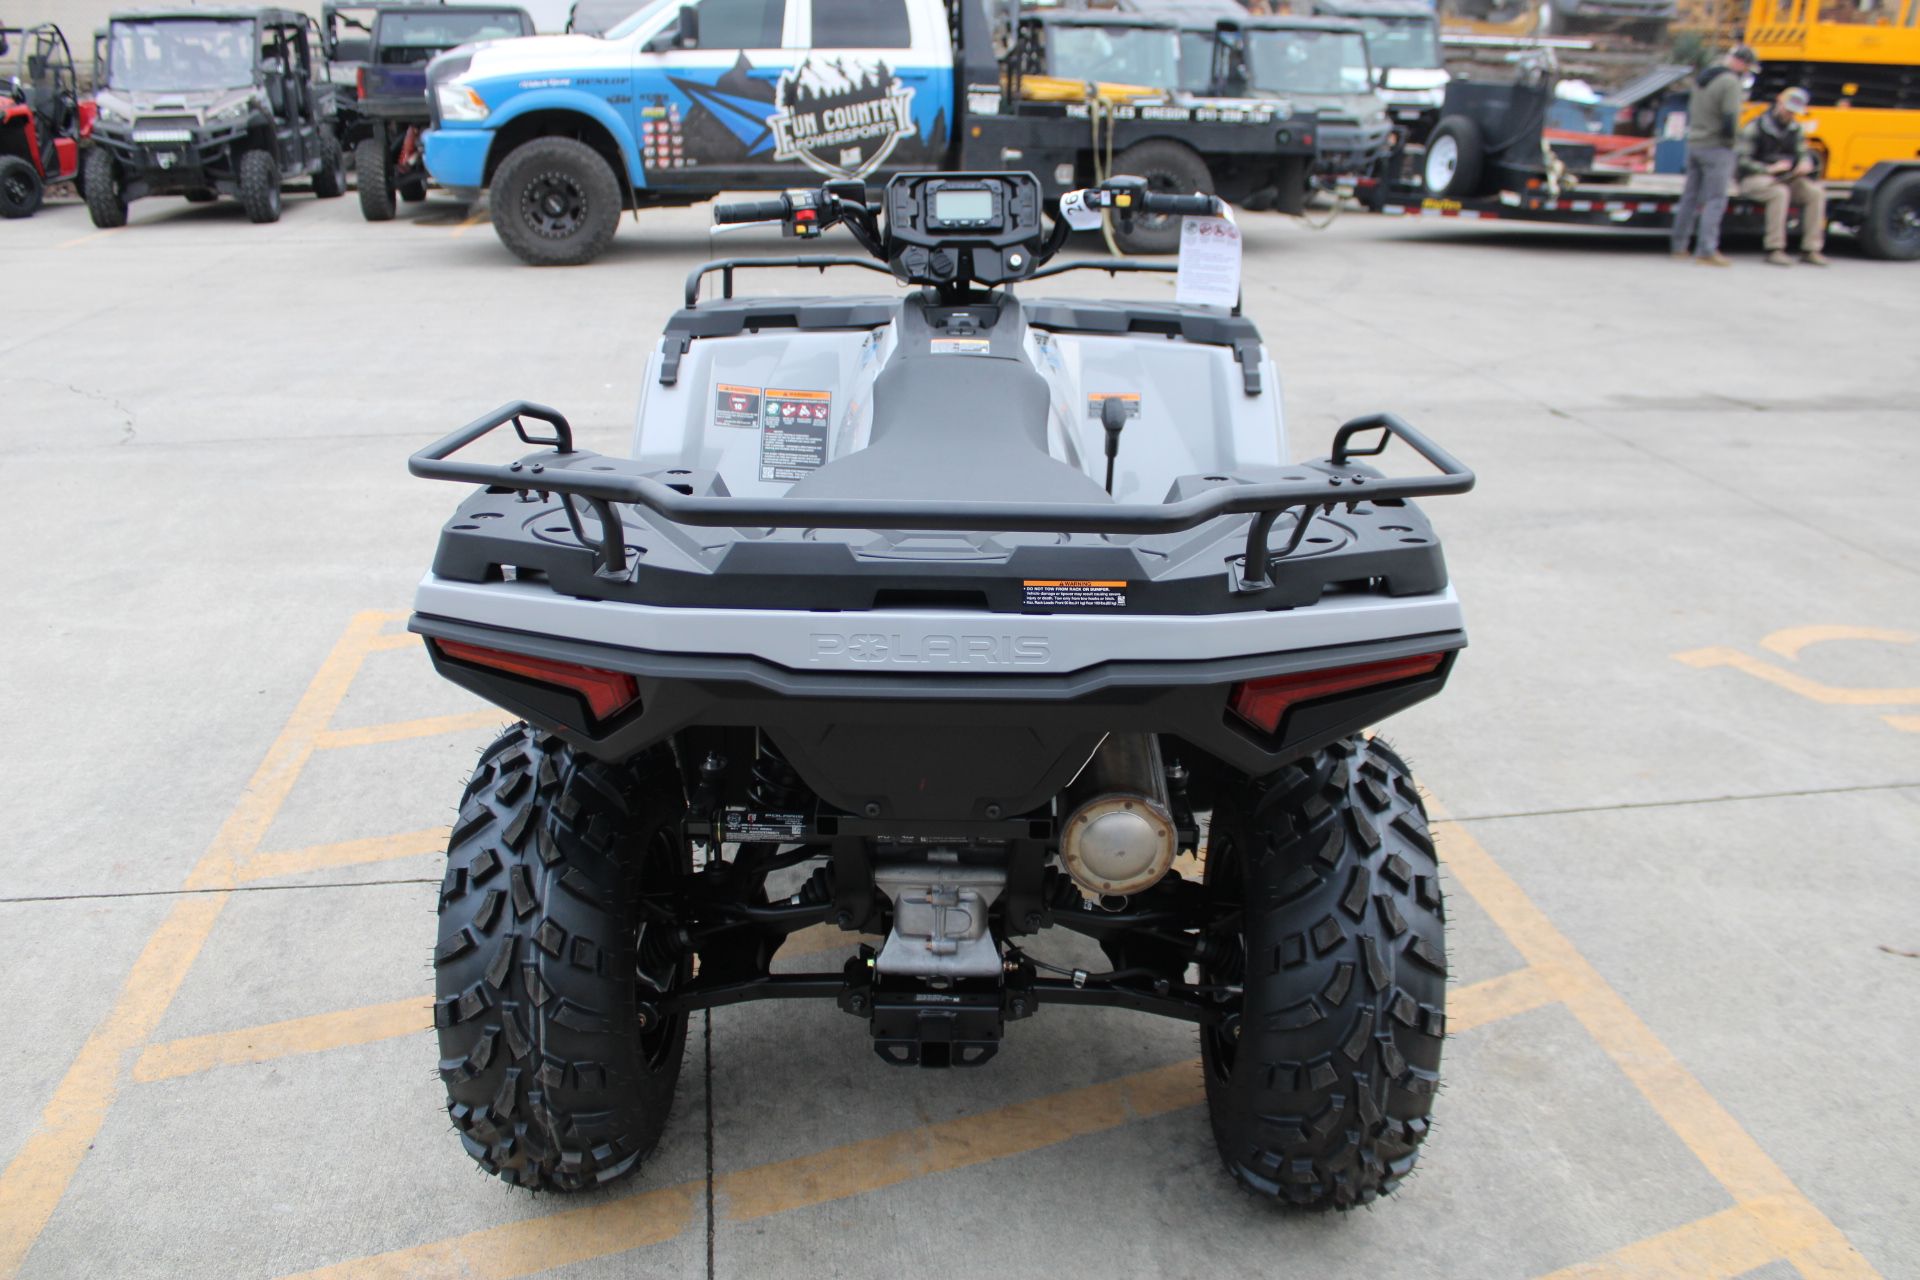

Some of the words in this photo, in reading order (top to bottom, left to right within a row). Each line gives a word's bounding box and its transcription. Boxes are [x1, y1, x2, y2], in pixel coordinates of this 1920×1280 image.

[767, 105, 818, 160] FUN
[822, 87, 916, 137] COUNTRY
[1142, 105, 1190, 121] OREGON
[796, 120, 897, 150] POWERSPORTS
[808, 633, 1051, 665] POLARIS
